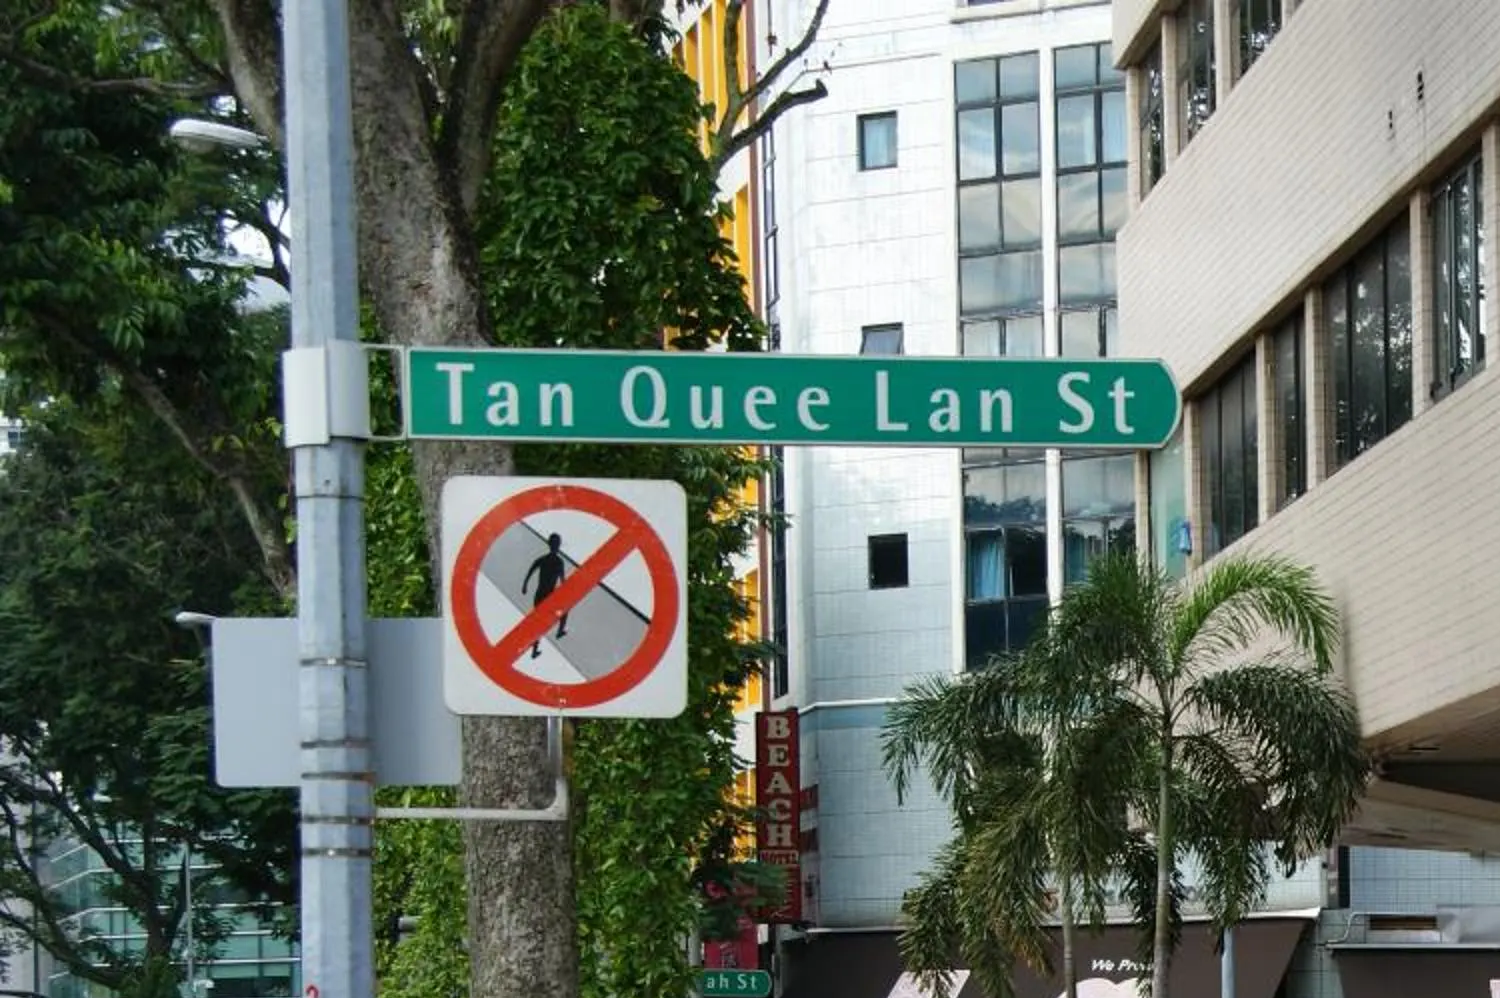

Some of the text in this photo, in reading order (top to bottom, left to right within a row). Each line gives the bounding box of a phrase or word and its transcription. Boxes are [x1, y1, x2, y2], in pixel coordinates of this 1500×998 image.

[435, 362, 1136, 436] Tan Quee Lan St
[766, 716, 793, 848] BEACH
[706, 972, 758, 990] ah St
